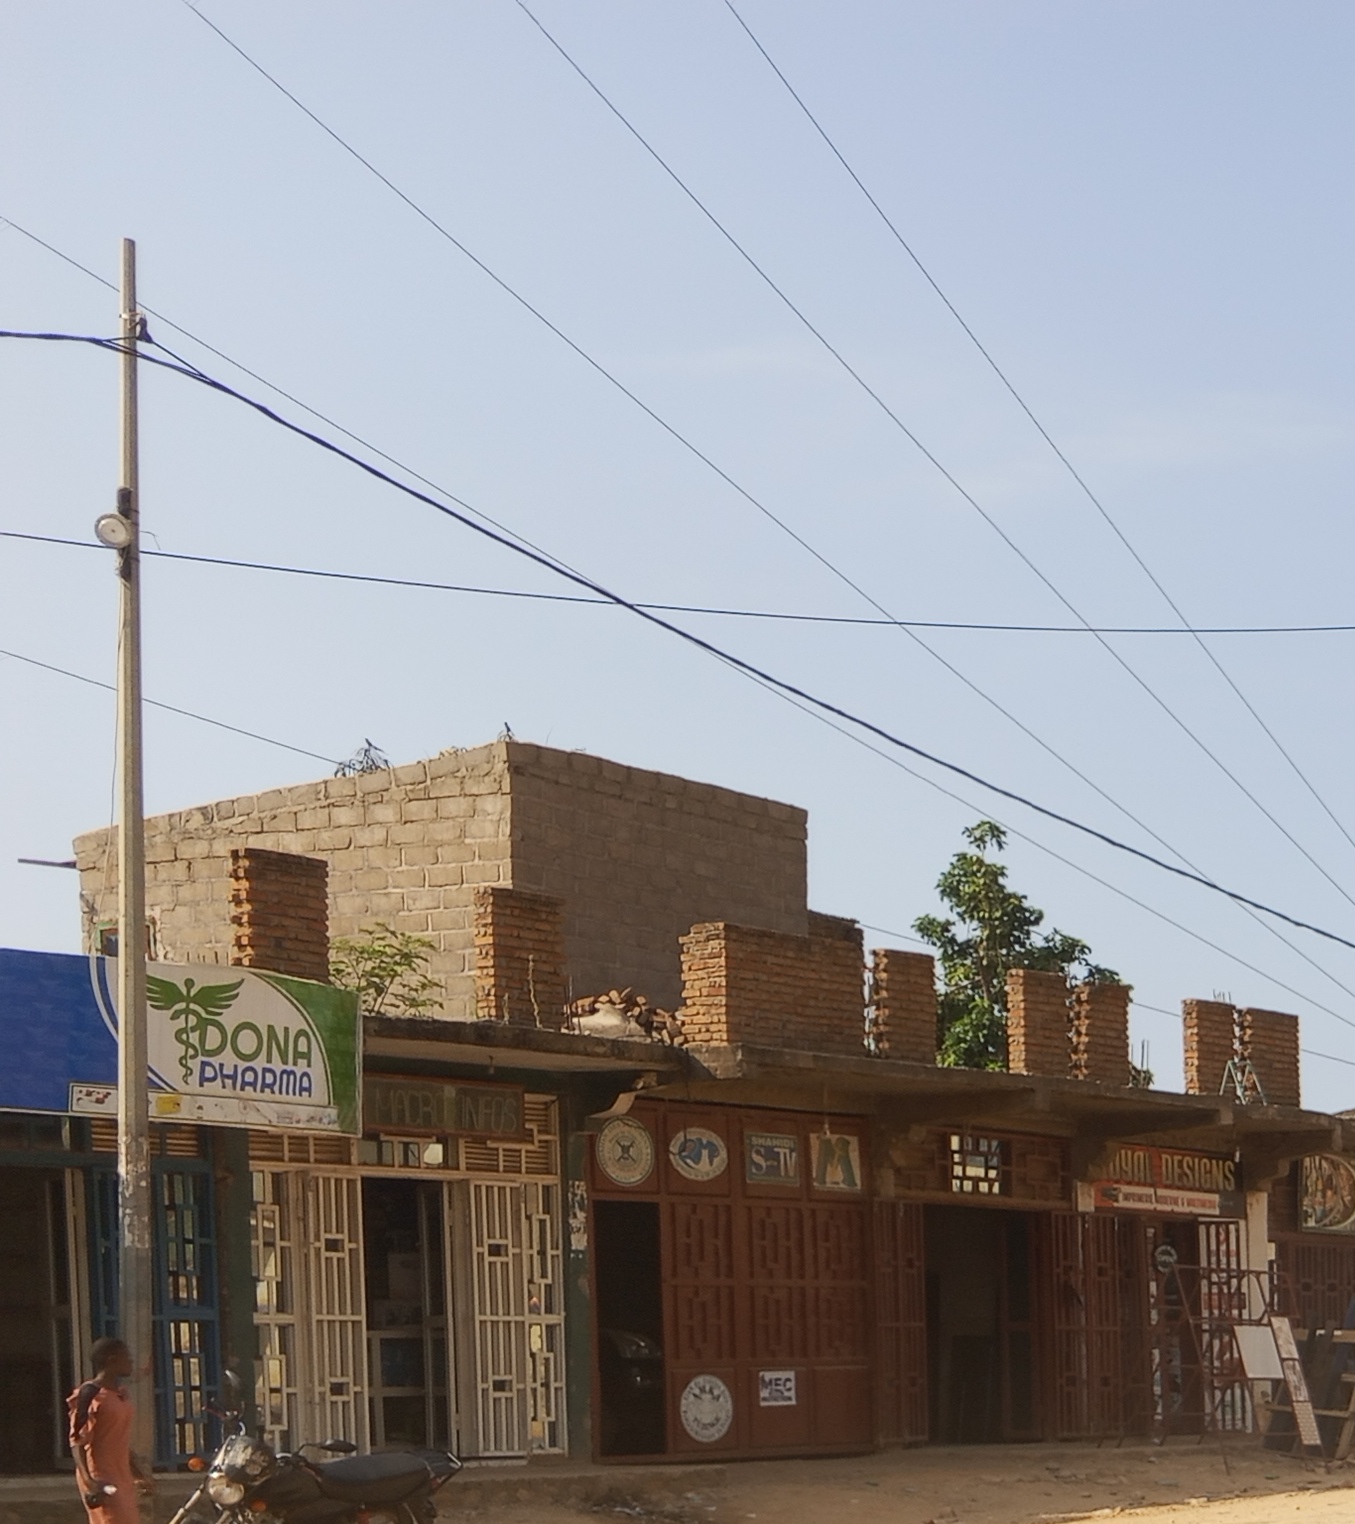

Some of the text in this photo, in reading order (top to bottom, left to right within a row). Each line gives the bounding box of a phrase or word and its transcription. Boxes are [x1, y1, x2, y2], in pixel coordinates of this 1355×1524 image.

[199, 1018, 312, 1068] DONA
[199, 1060, 312, 1098] PHARMA
[751, 1135, 796, 1149] SHAHIDI
[1161, 1153, 1236, 1191] DESIGNS
